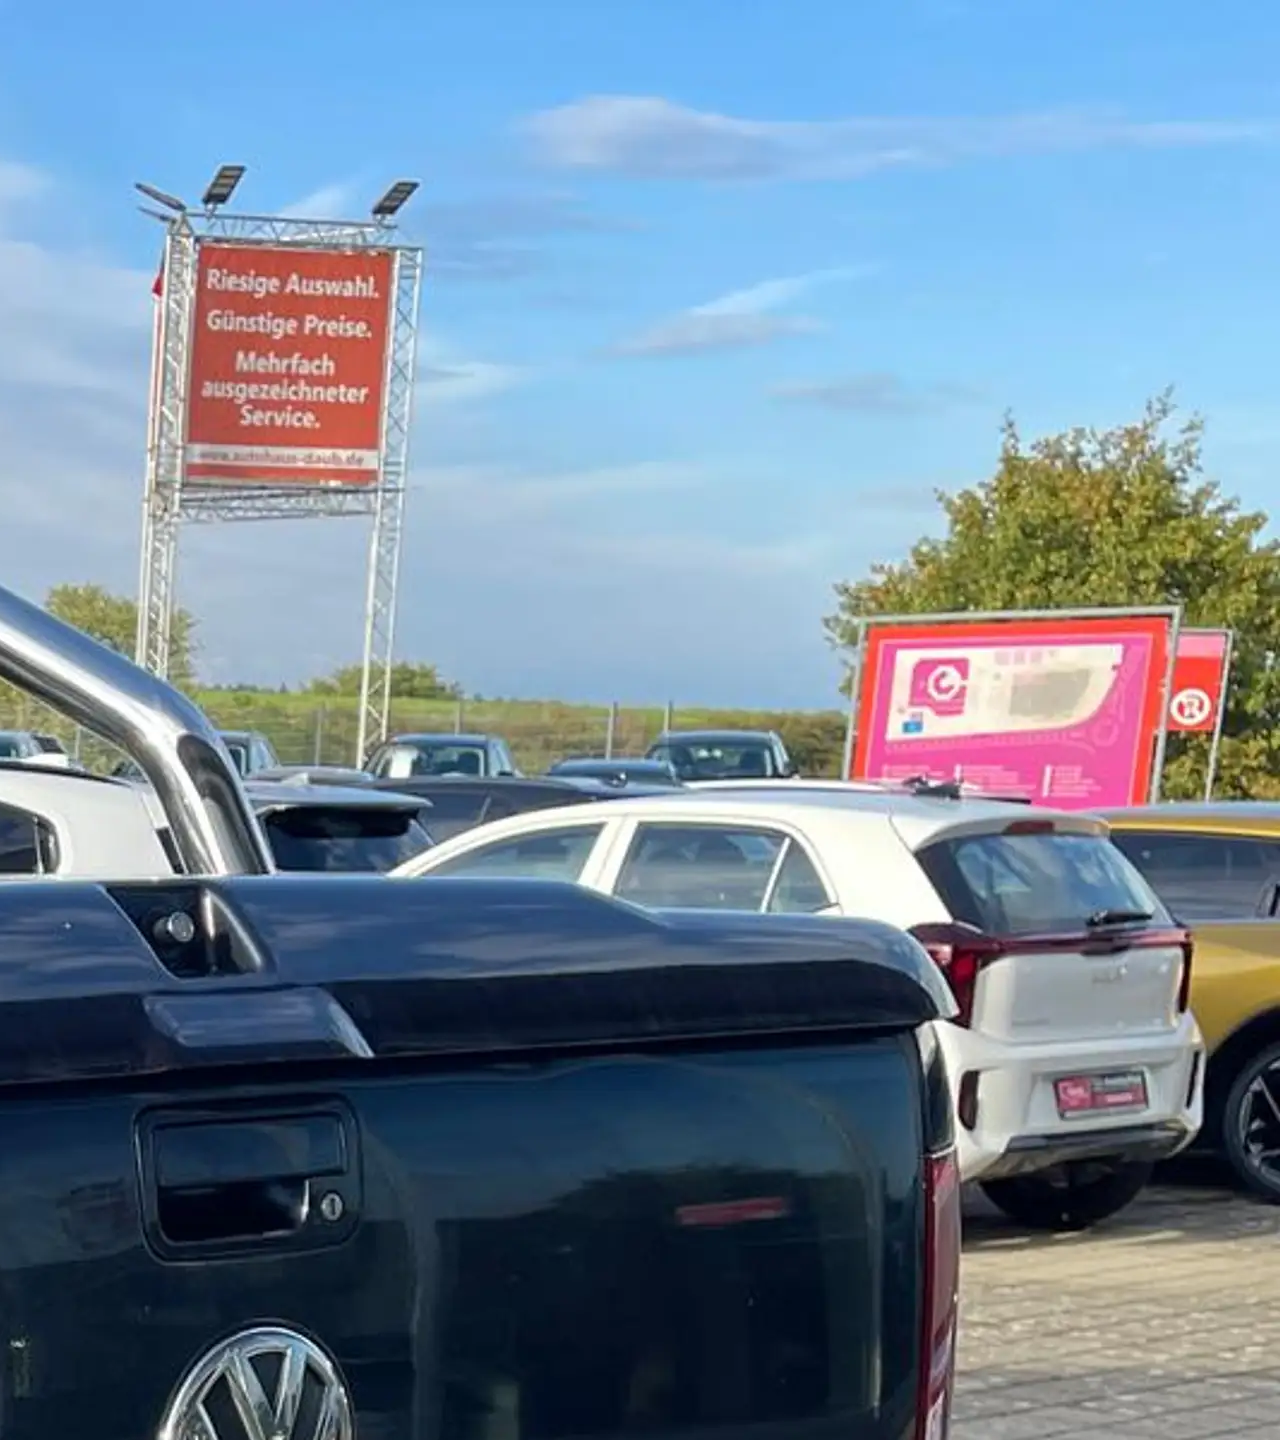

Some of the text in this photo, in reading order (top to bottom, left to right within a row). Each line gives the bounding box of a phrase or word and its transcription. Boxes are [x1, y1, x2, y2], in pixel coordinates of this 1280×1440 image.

[206, 269, 378, 298] Riesige Auswahl.
[207, 311, 372, 339] Günstige Preise.
[236, 351, 335, 376] Mehrfach
[202, 379, 369, 404] ausgezeichneter
[240, 404, 321, 428] Service.
